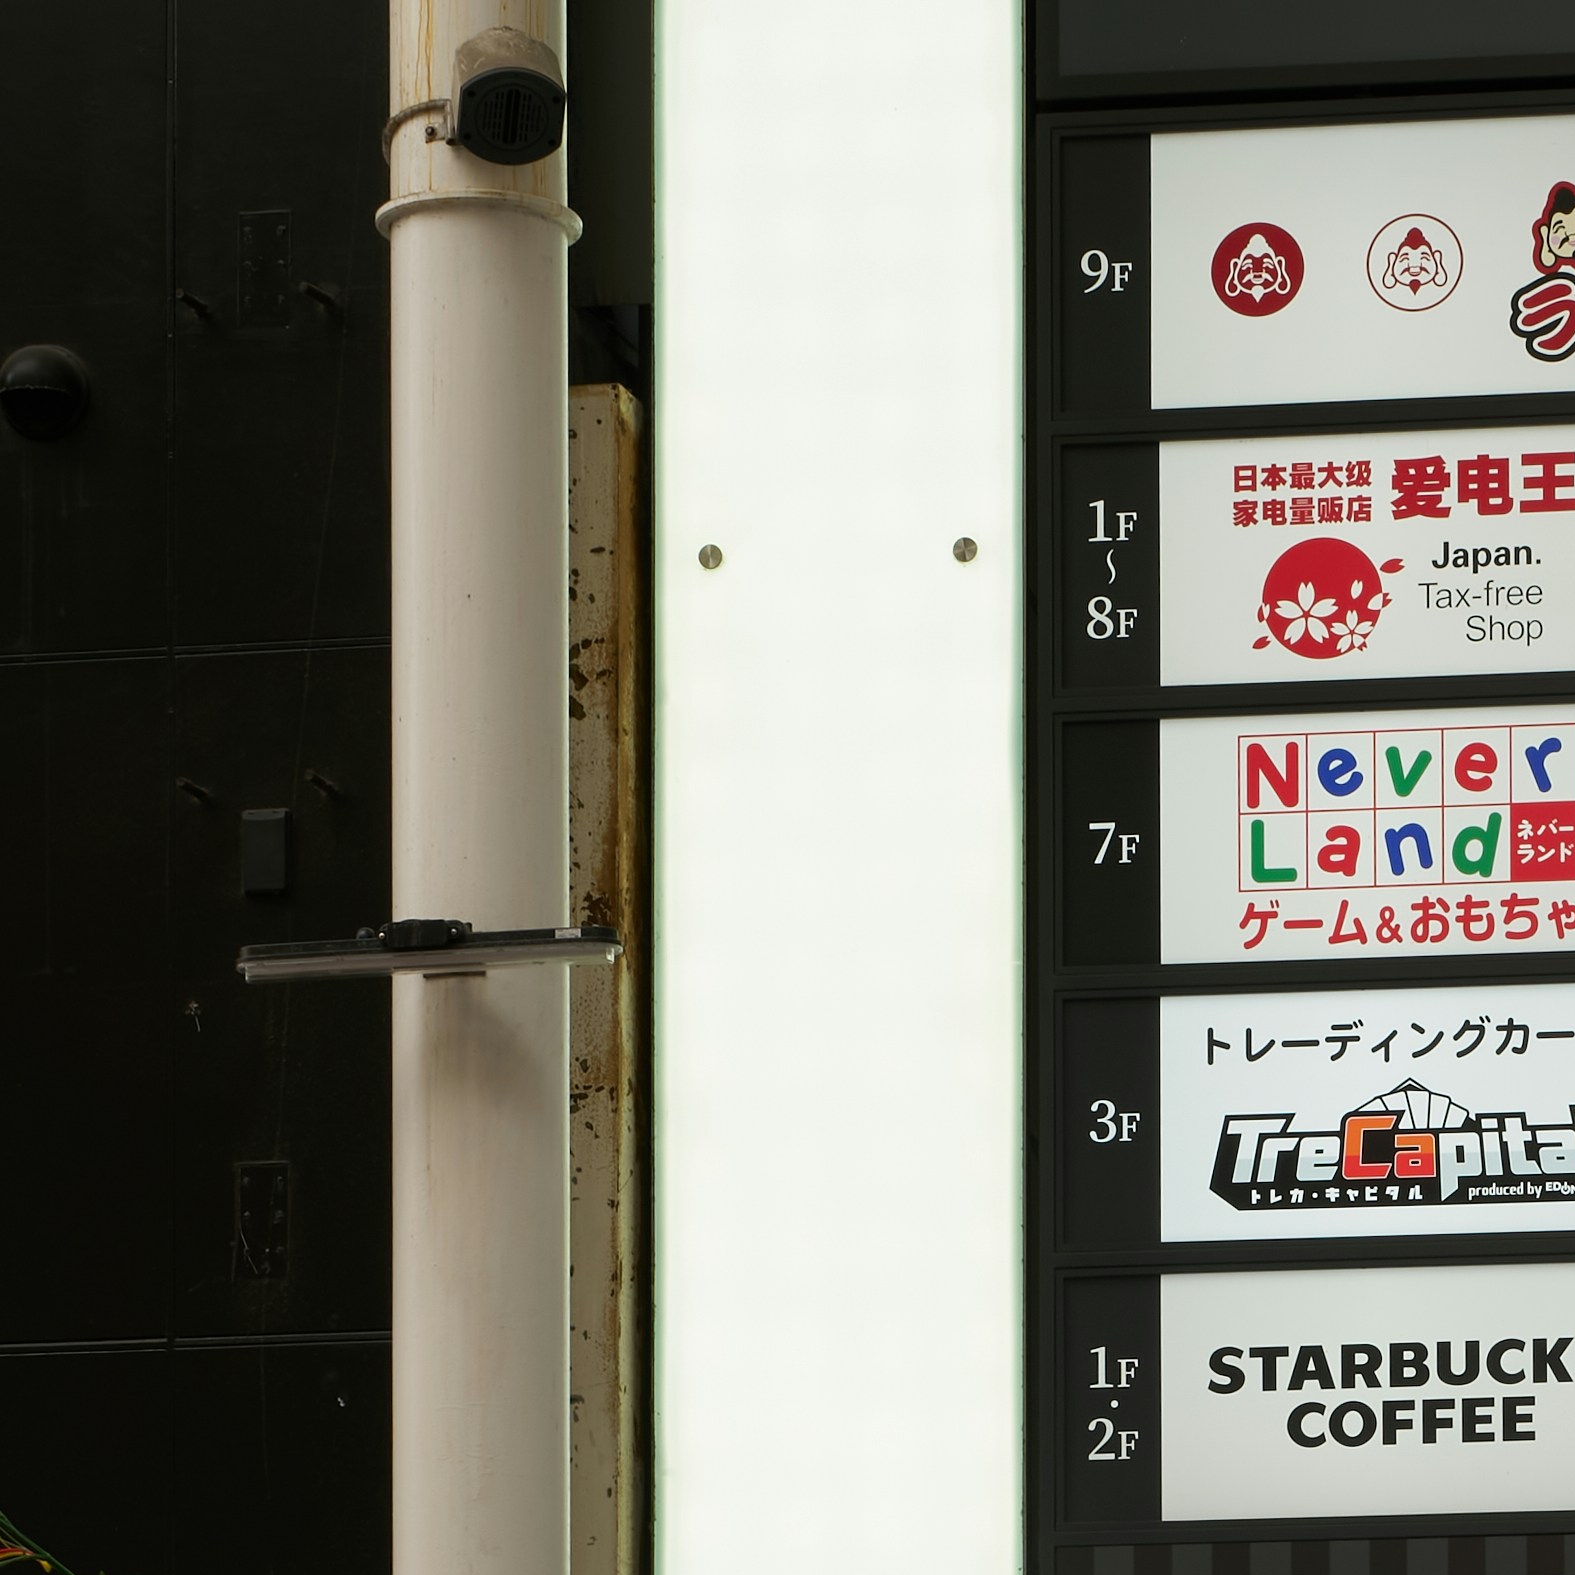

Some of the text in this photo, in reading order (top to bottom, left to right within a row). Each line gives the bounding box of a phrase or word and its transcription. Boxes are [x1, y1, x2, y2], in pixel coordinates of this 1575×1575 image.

[1080, 250, 1132, 293] 9F
[1234, 460, 1372, 492] 日本最大级
[1088, 500, 1137, 543] 1F
[1233, 495, 1372, 527] 家电量贩店
[1432, 541, 1542, 573] Japan.
[1419, 579, 1543, 609] Tax-free
[1086, 596, 1138, 639] 8F
[1466, 615, 1543, 646] Shop
[1246, 737, 1562, 809] Never
[1089, 822, 1140, 864] 7F
[1250, 811, 1503, 883] Land
[1516, 819, 1575, 840] ネバー
[1516, 841, 1575, 865] ランド
[1089, 1101, 1140, 1143] 3F
[1251, 1183, 1423, 1204] トレカ・キャピタル
[1468, 1181, 1522, 1199] produced
[1526, 1181, 1542, 1199] by
[1089, 1346, 1139, 1389] 1F
[1088, 1418, 1139, 1461] 2F
[1287, 1396, 1536, 1449] COFFEE
